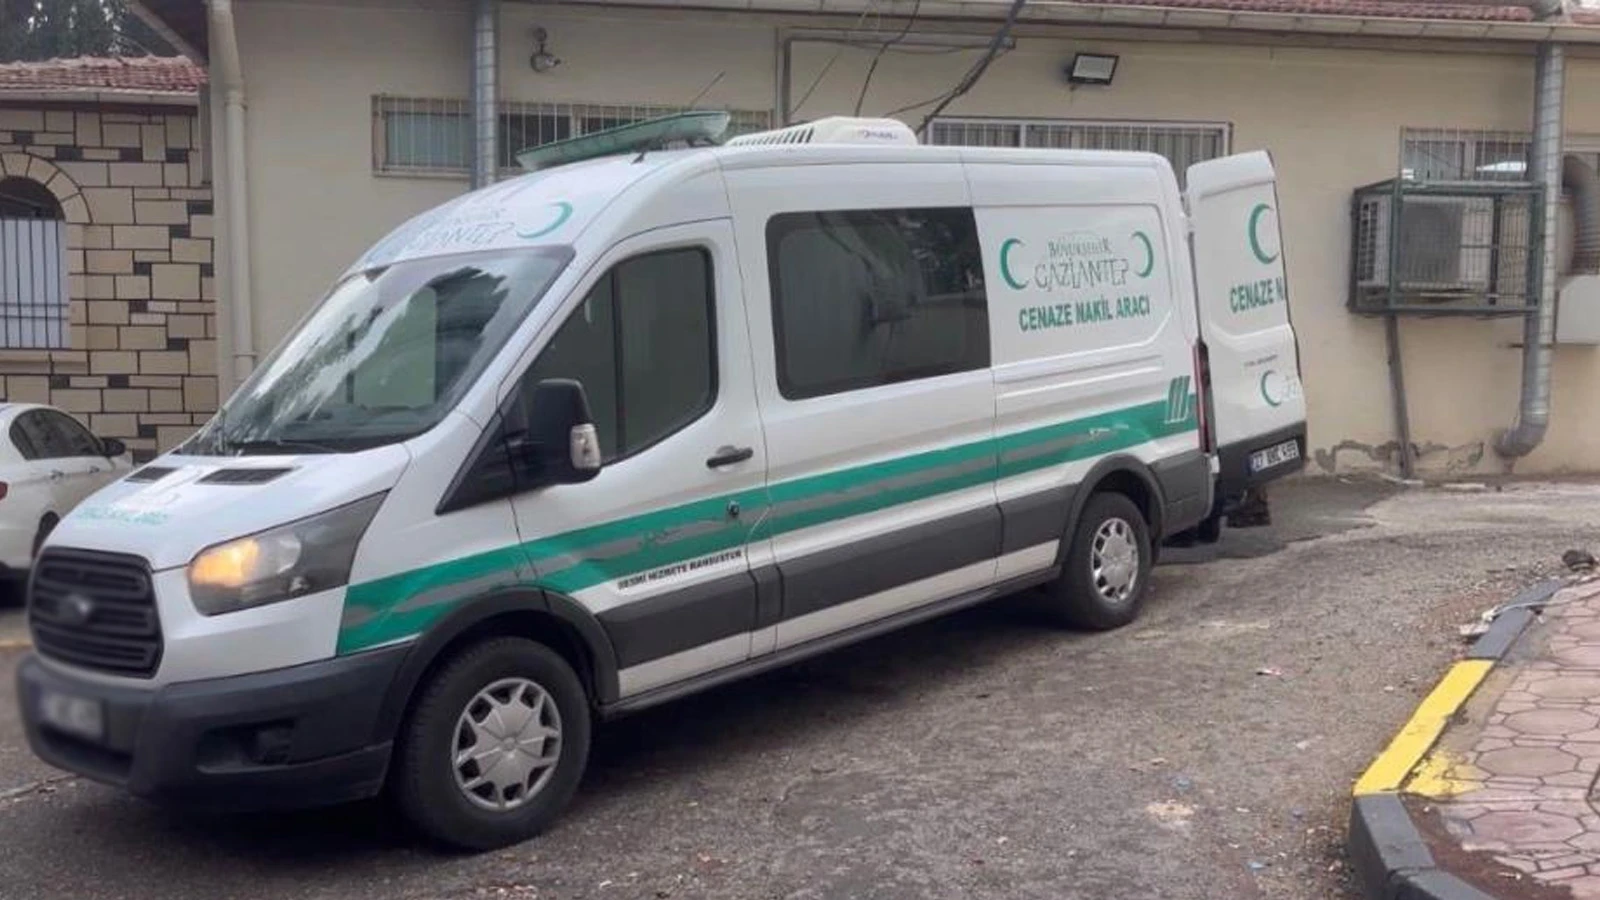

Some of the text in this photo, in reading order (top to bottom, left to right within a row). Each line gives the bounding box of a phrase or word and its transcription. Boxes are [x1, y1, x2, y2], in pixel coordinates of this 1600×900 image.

[1019, 295, 1151, 332] CENAZE NAKİL ARACI
[1230, 279, 1273, 313] CENAZE
